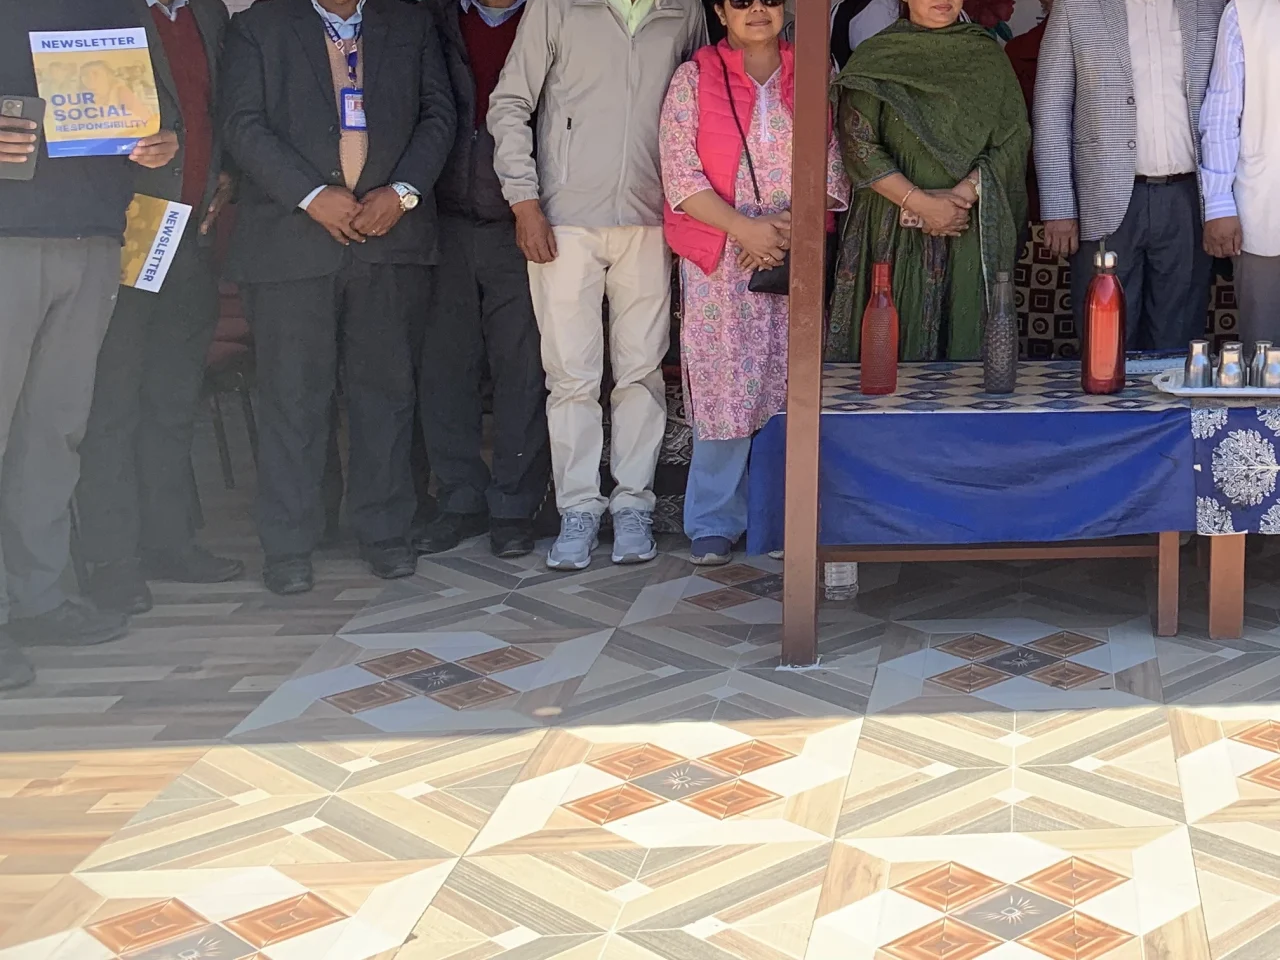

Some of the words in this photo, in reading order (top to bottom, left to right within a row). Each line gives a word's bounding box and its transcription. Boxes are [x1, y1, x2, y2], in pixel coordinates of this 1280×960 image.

[41, 36, 135, 49] NEWSLETTER
[51, 92, 96, 107] OUR
[54, 103, 132, 122] SOCIAL
[55, 119, 149, 133] RESPONSIBILITY
[143, 210, 180, 282] NEWSLETTER
